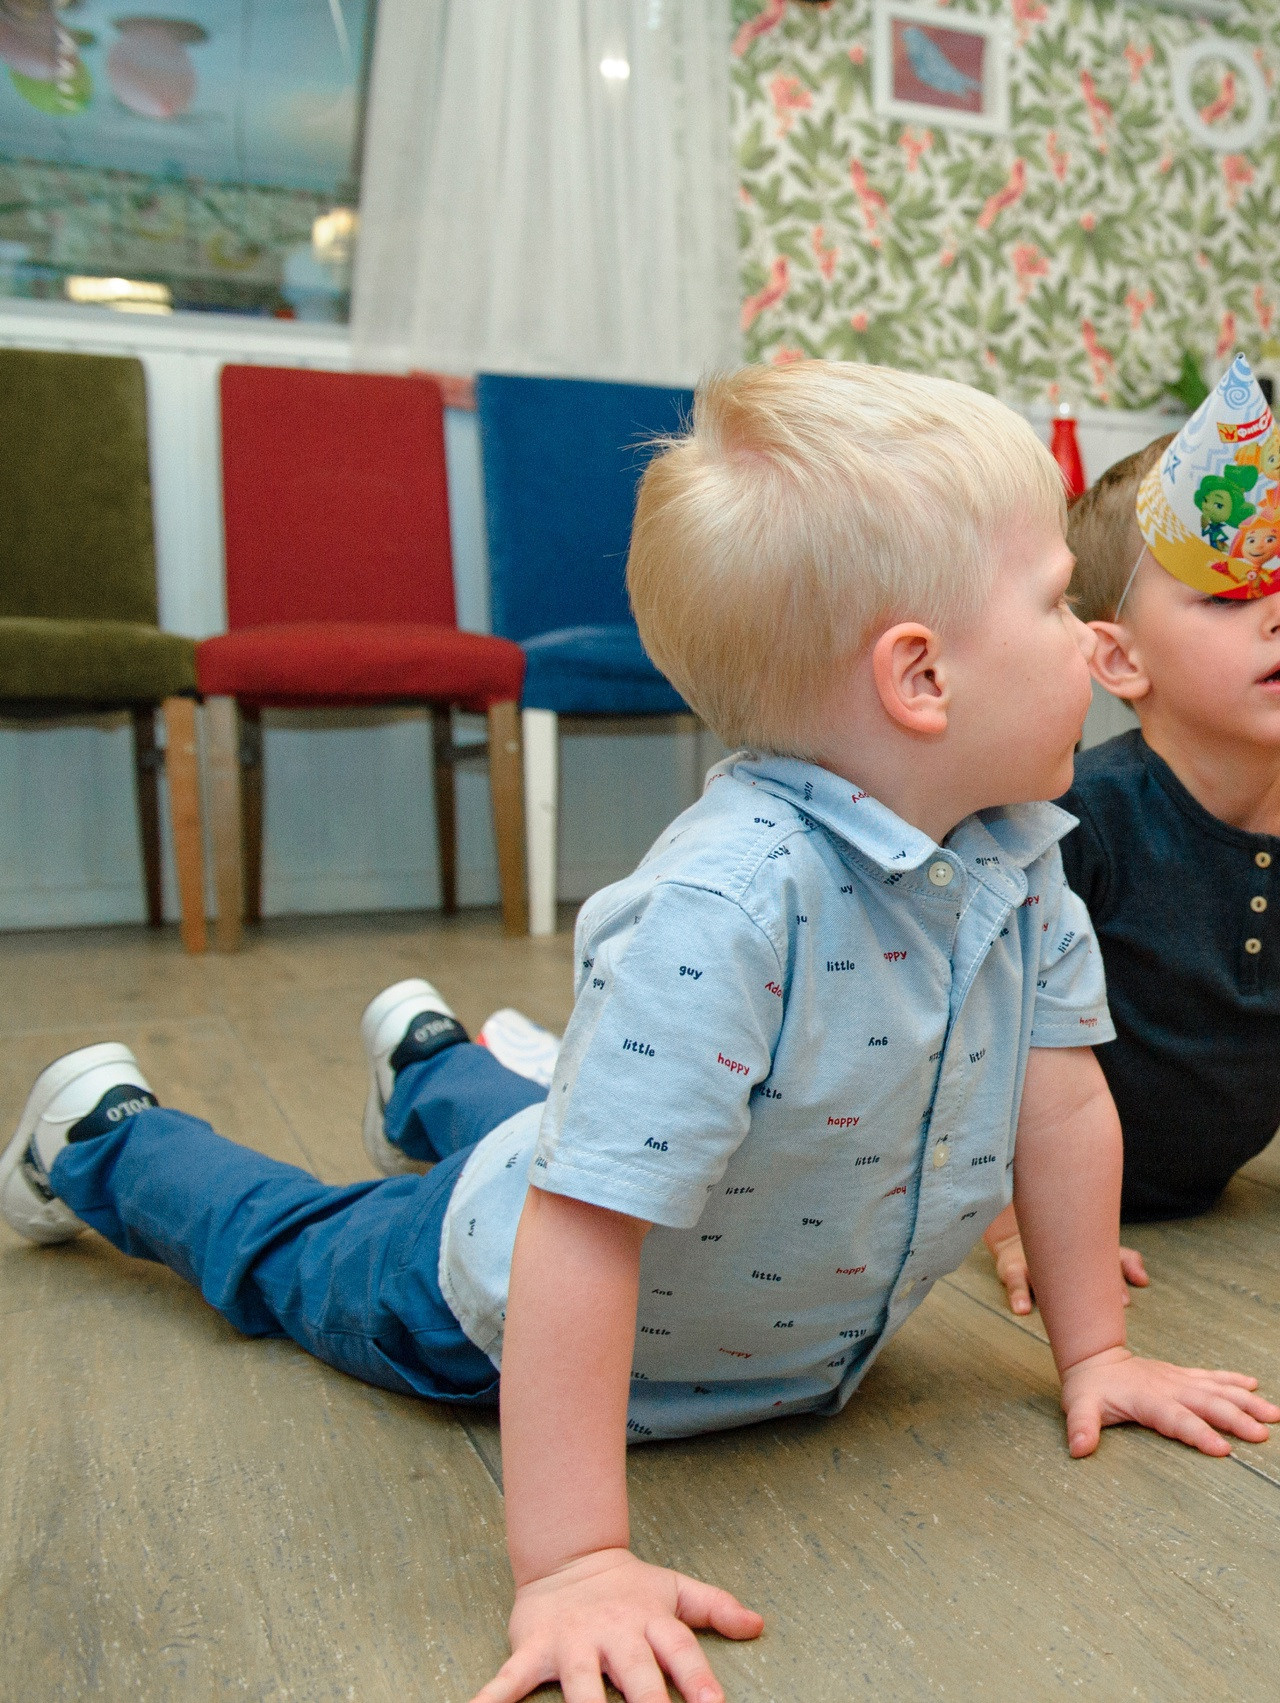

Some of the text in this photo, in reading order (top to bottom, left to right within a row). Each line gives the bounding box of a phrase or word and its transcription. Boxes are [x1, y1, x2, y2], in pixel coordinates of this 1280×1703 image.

[754, 817, 776, 828] guy
[1058, 931, 1075, 954] little
[827, 960, 855, 972] little
[679, 966, 703, 980] guy
[868, 1037, 888, 1046] guy
[623, 1039, 655, 1057] little
[717, 1053, 750, 1075] happy
[106, 1096, 151, 1122] POLO
[827, 1116, 860, 1127] happy
[644, 1137, 669, 1151] guy
[855, 1155, 880, 1166] little
[971, 1154, 997, 1167] little
[726, 1186, 755, 1195] little
[802, 1217, 823, 1227] guy
[701, 1234, 722, 1242] guy
[751, 1270, 782, 1282] little
[836, 1265, 867, 1276] happy
[773, 1320, 794, 1328] guy
[641, 1326, 671, 1336] little
[627, 1418, 652, 1435] little
